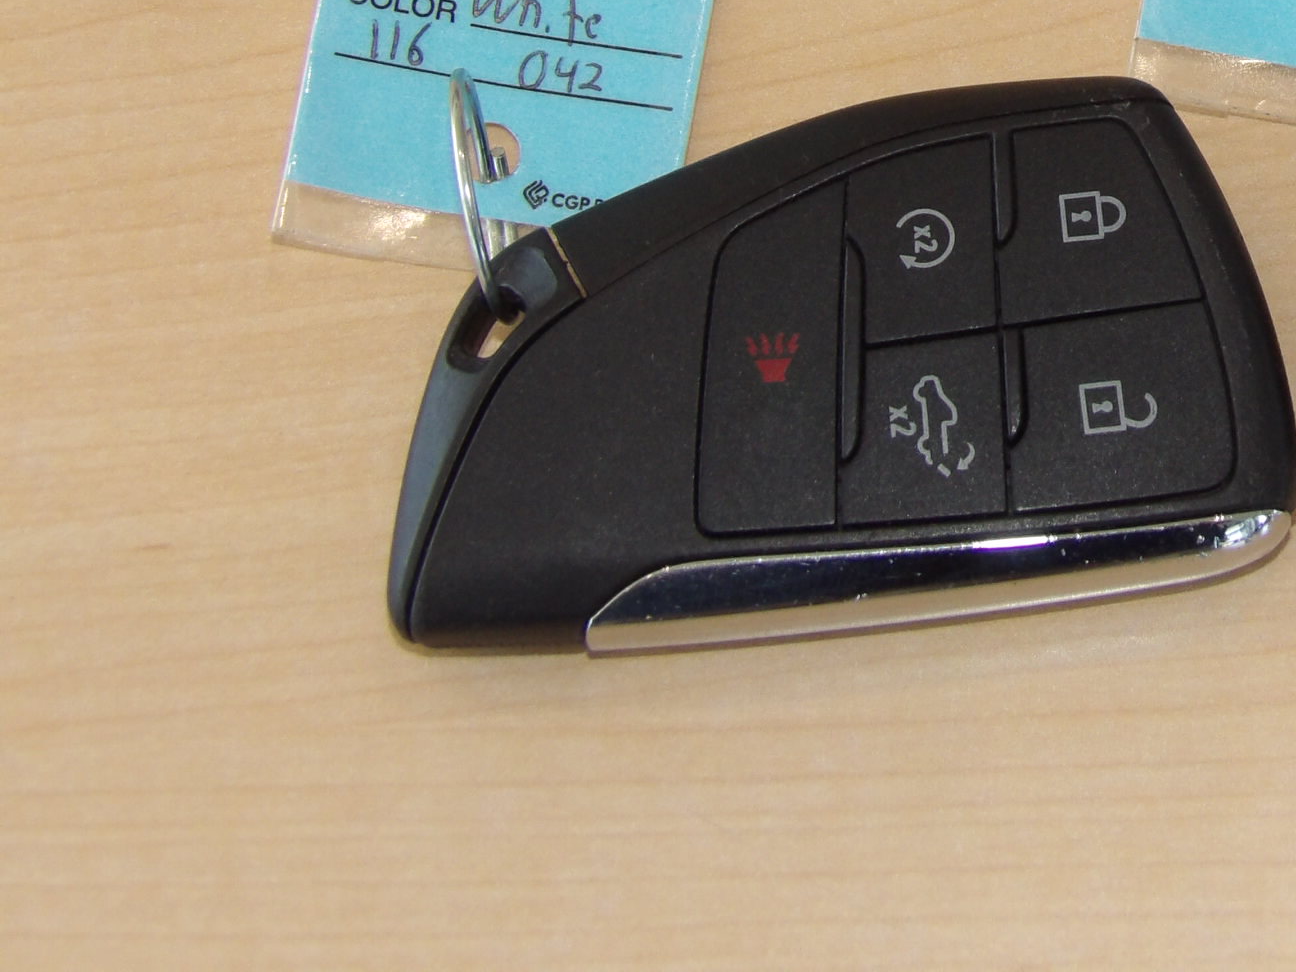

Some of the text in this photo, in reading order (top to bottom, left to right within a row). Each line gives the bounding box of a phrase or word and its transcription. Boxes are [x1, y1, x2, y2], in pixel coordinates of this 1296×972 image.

[370, 19, 603, 93] 116 042
[551, 193, 591, 210] CGP
